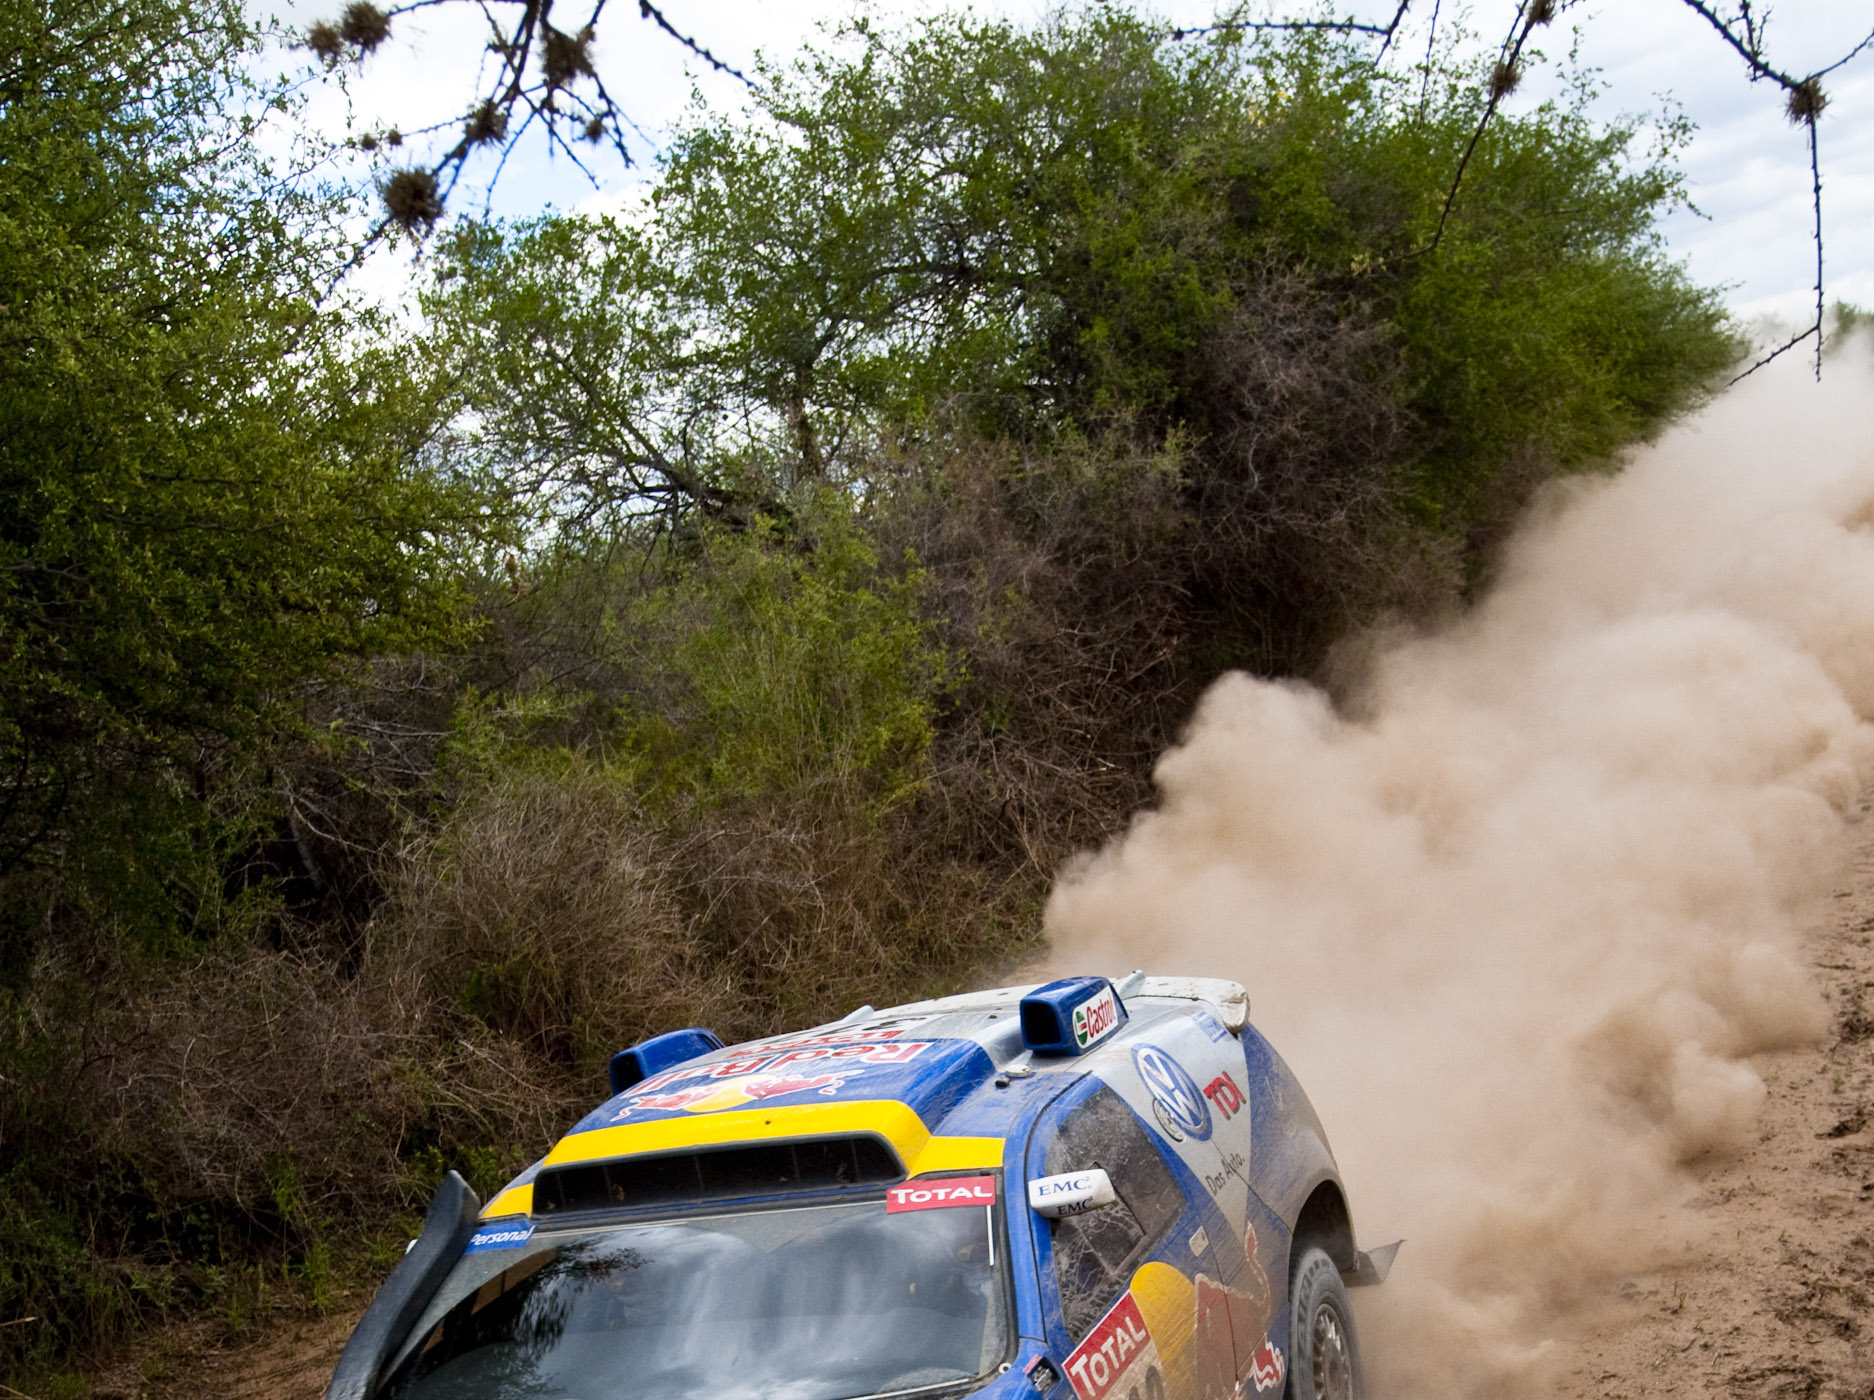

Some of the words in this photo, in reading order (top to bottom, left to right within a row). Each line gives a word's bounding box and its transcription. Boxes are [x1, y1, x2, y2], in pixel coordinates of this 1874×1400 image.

[1086, 992, 1116, 1038] Castrol
[760, 1042, 934, 1072] Red
[1203, 1071, 1247, 1120] TDI
[1205, 1171, 1226, 1197] Das
[470, 1225, 536, 1246] Personal
[1070, 1316, 1147, 1397] TOTAL
